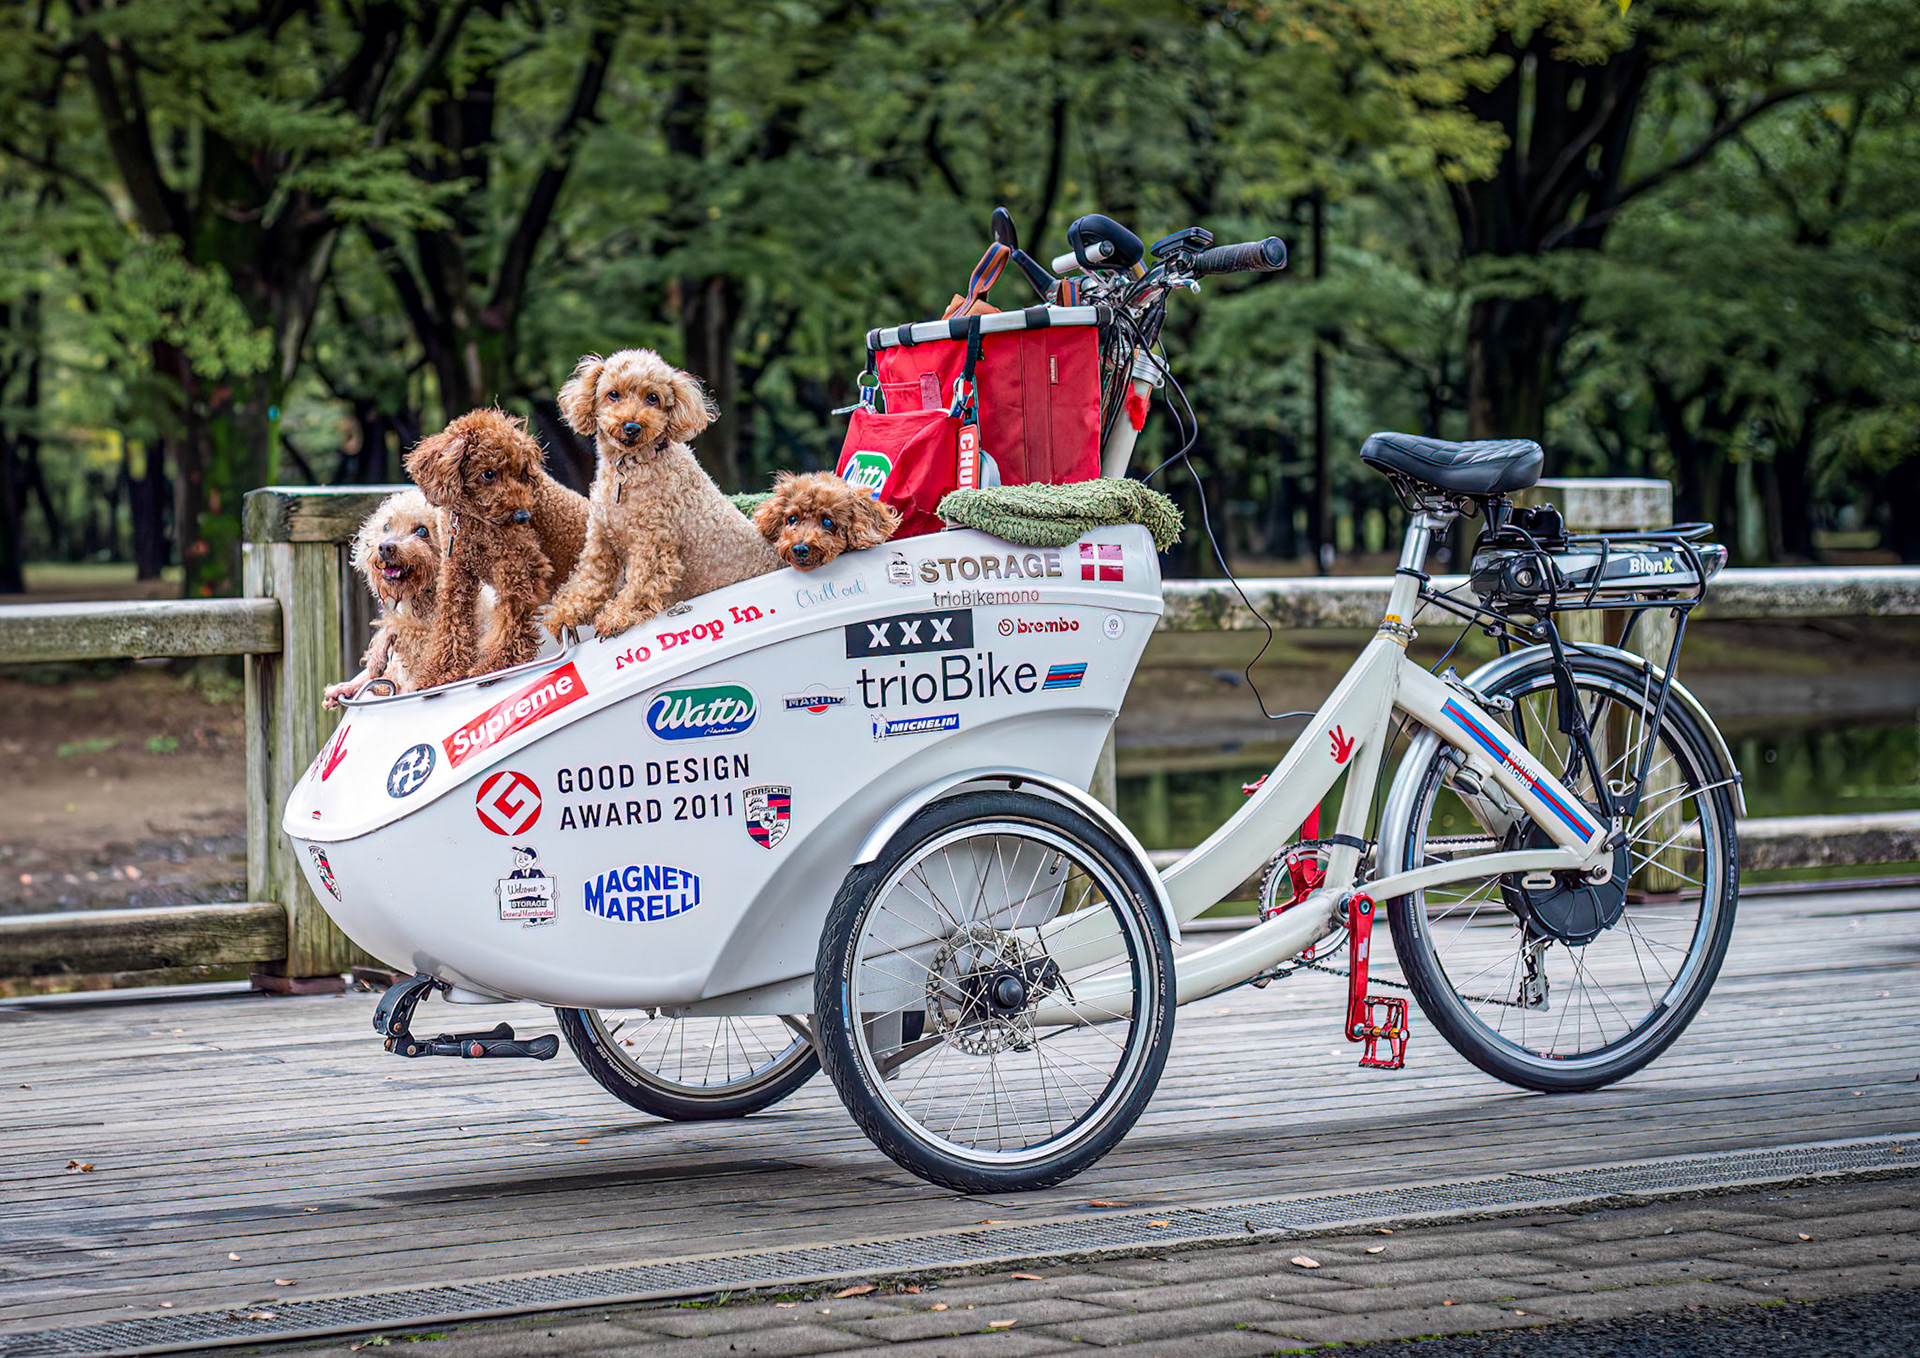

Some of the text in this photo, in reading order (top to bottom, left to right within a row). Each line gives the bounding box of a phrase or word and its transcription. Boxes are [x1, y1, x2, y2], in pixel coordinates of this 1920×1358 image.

[959, 433, 974, 490] CHU
[919, 553, 1063, 583] STORAGE
[796, 579, 866, 609] Chill out
[933, 589, 1040, 607] trioBikemono
[1017, 617, 1080, 634] brembo
[615, 646, 651, 670] No
[656, 618, 725, 651] Drop
[856, 651, 1038, 709] trioBike
[453, 674, 575, 757] Supreme
[650, 695, 755, 731] Watts
[890, 716, 957, 733] MICHELIN
[556, 753, 750, 794] GOOD DESIGN
[745, 787, 790, 799] PORSCHE
[559, 792, 734, 831] AWARD 2011
[584, 865, 700, 902] MAGNETI
[511, 900, 548, 909] STORAGE
[584, 886, 700, 922] MARELLI
